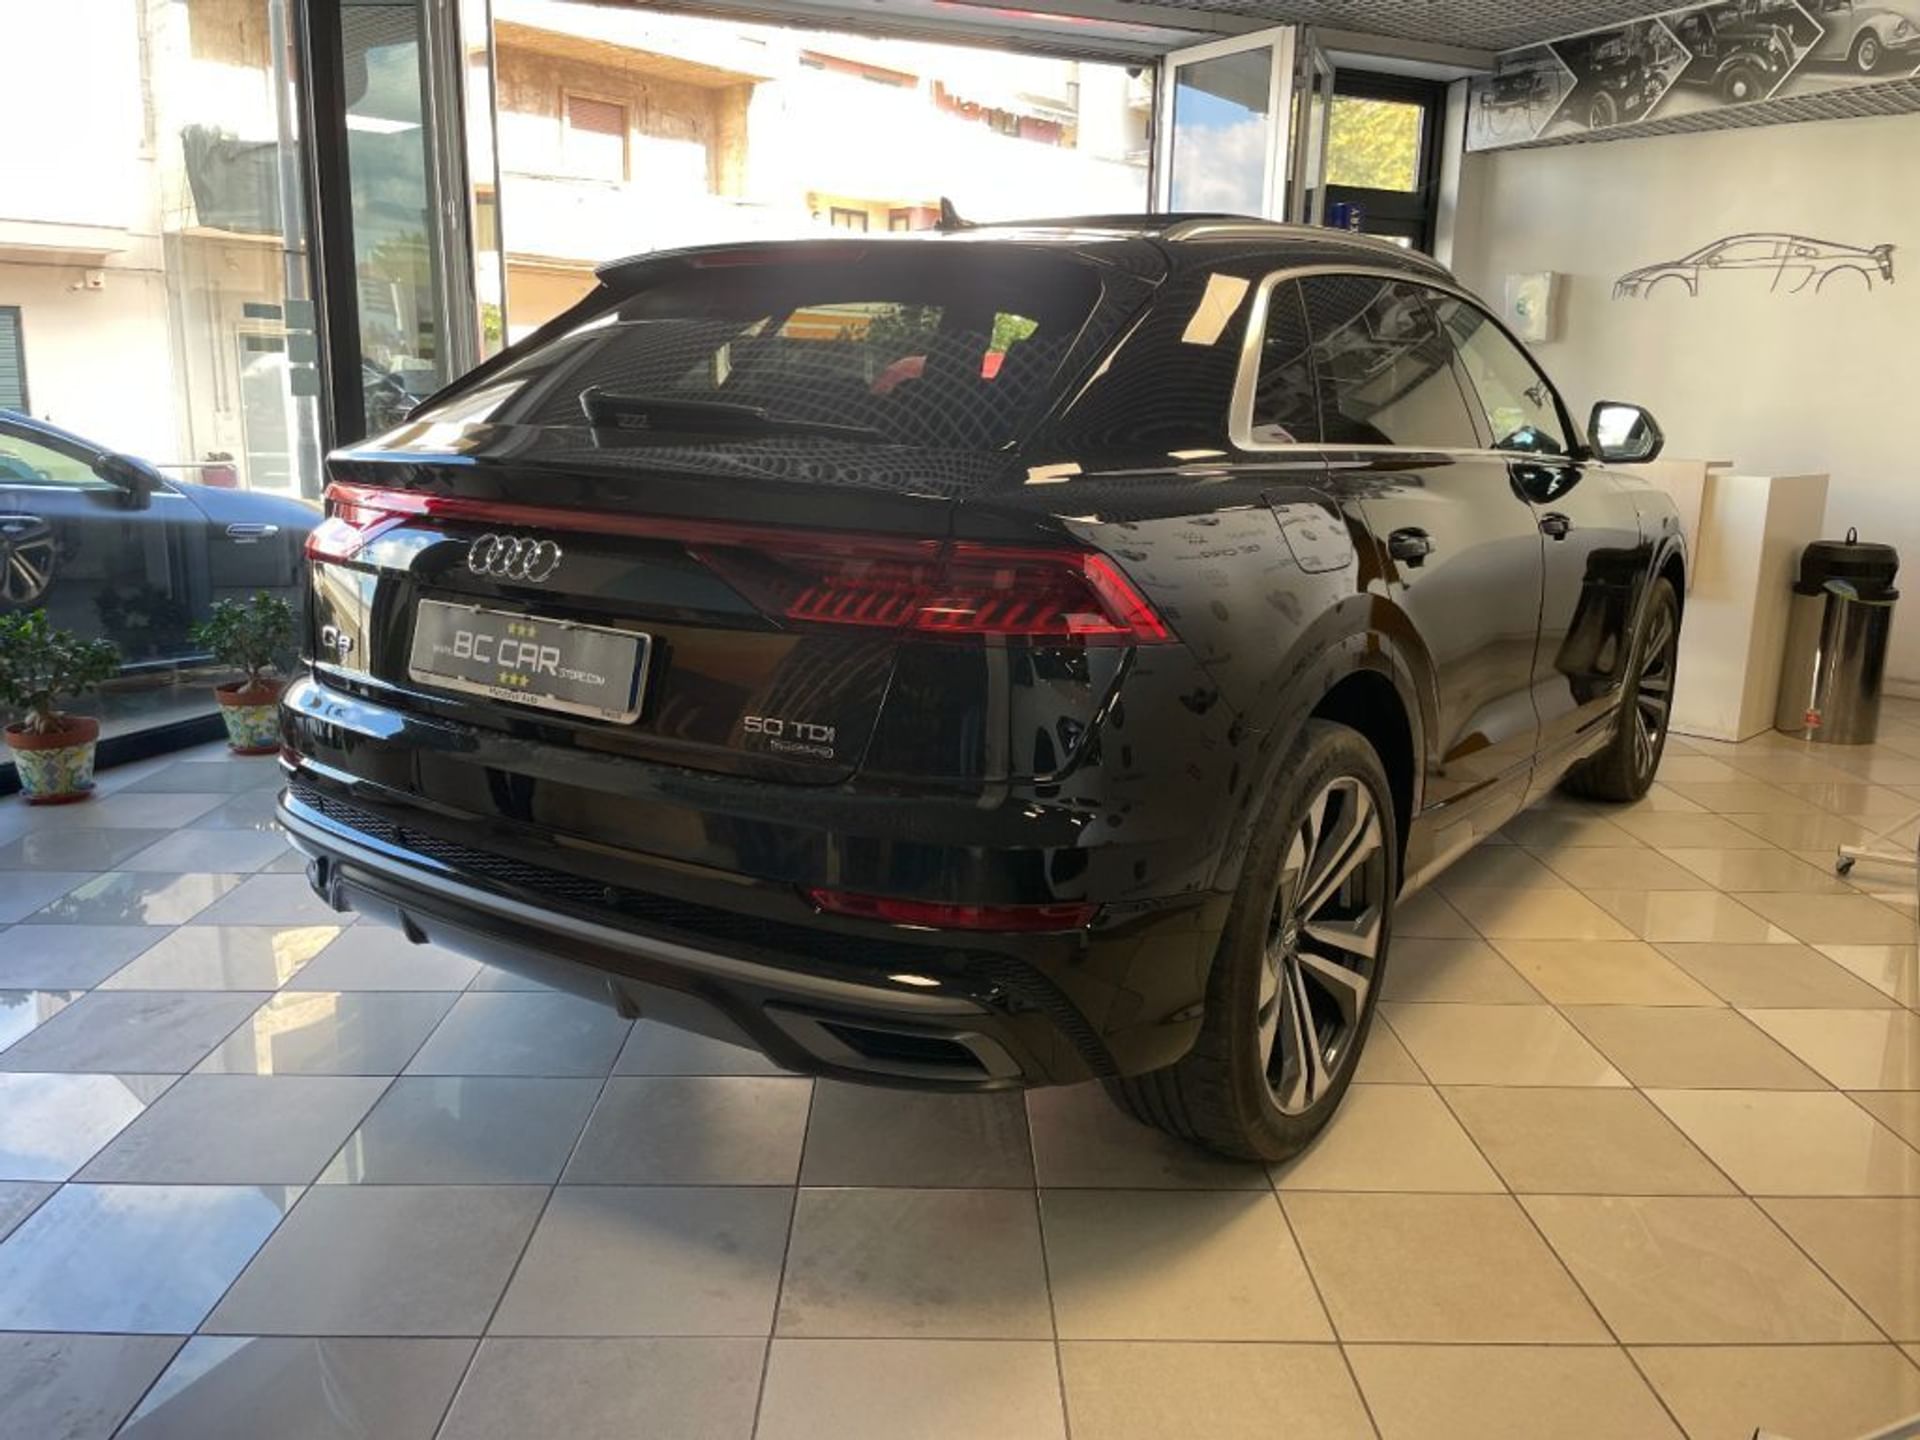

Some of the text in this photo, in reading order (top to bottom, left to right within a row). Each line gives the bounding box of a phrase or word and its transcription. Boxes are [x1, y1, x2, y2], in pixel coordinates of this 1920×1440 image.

[453, 630, 493, 662] BC
[497, 639, 561, 676] CAR
[744, 716, 836, 742] 50 TDI
